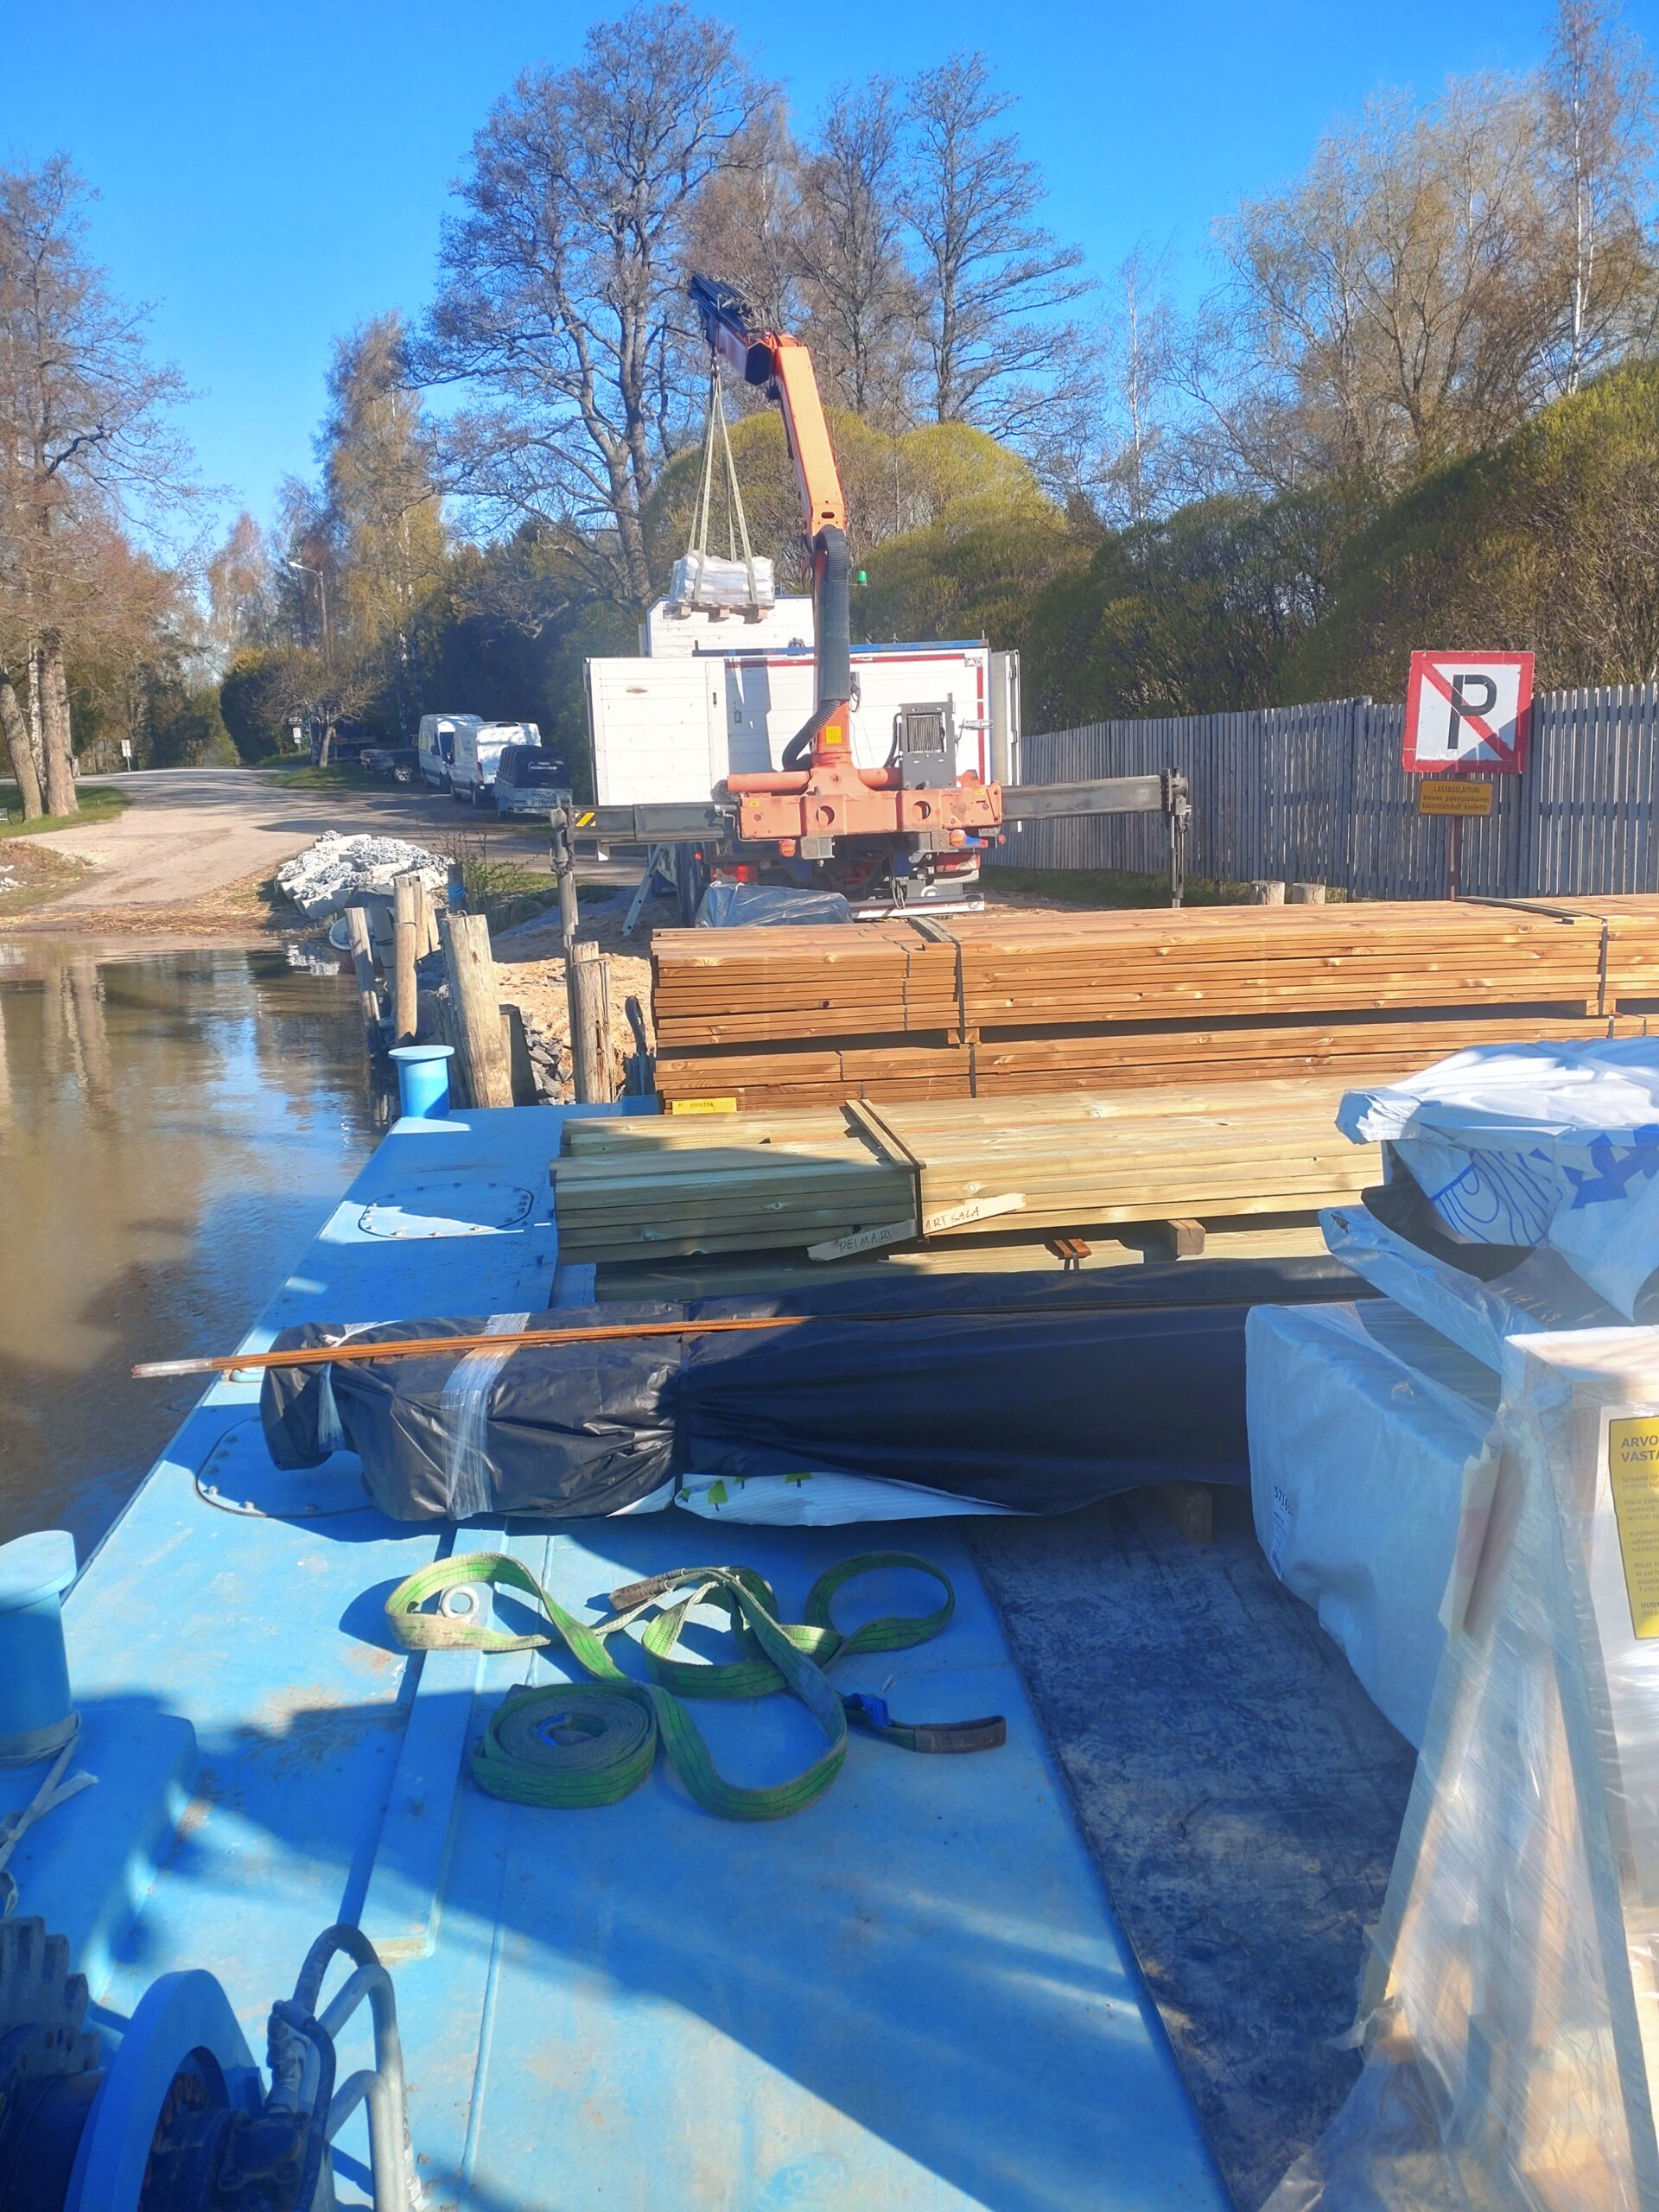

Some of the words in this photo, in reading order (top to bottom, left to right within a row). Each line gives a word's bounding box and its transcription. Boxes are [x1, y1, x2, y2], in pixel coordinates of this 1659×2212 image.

[1447, 675, 1497, 749] P
[925, 1215, 946, 1230] ART
[1621, 1435, 1659, 1448] ARVO
